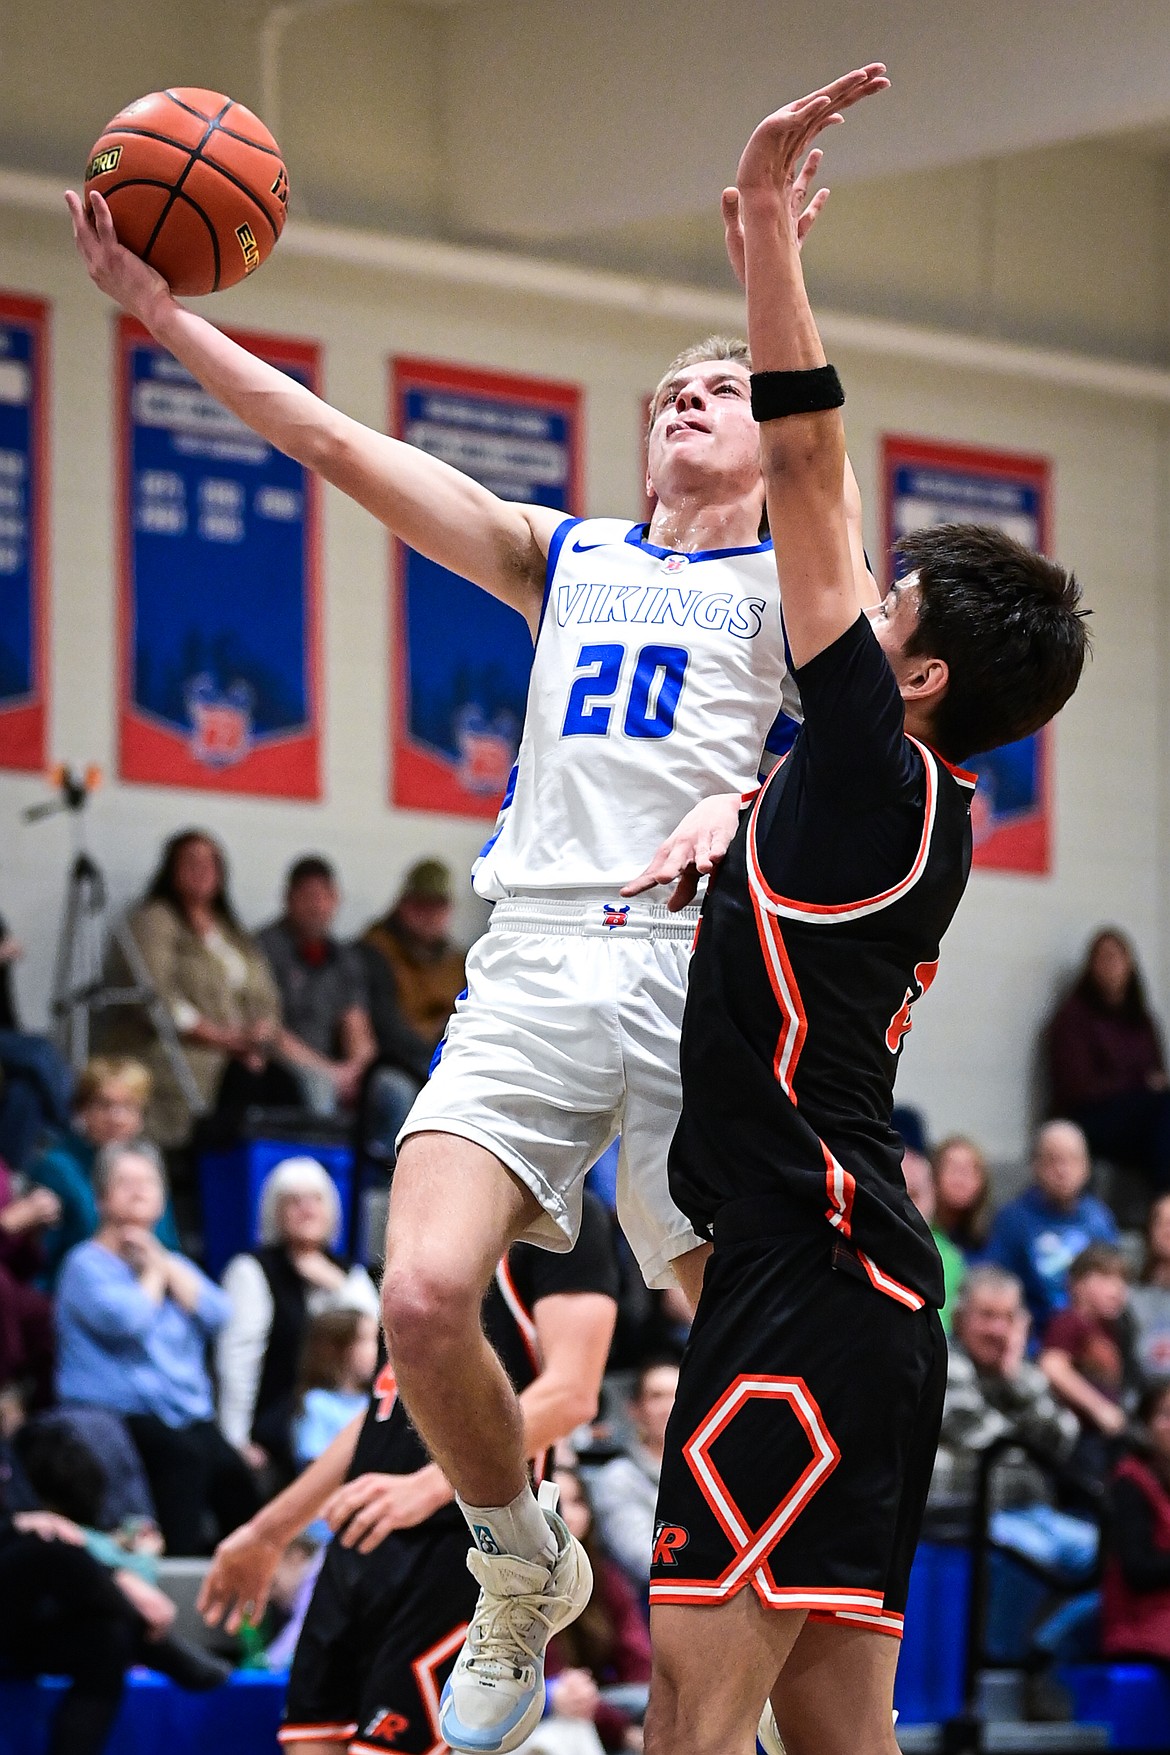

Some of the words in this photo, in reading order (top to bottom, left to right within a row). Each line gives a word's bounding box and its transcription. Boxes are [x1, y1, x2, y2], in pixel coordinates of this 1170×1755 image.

[91, 150, 119, 176] PRO
[235, 222, 259, 275] ELIT
[556, 583, 767, 640] VIKINGS
[559, 641, 692, 742] 20
